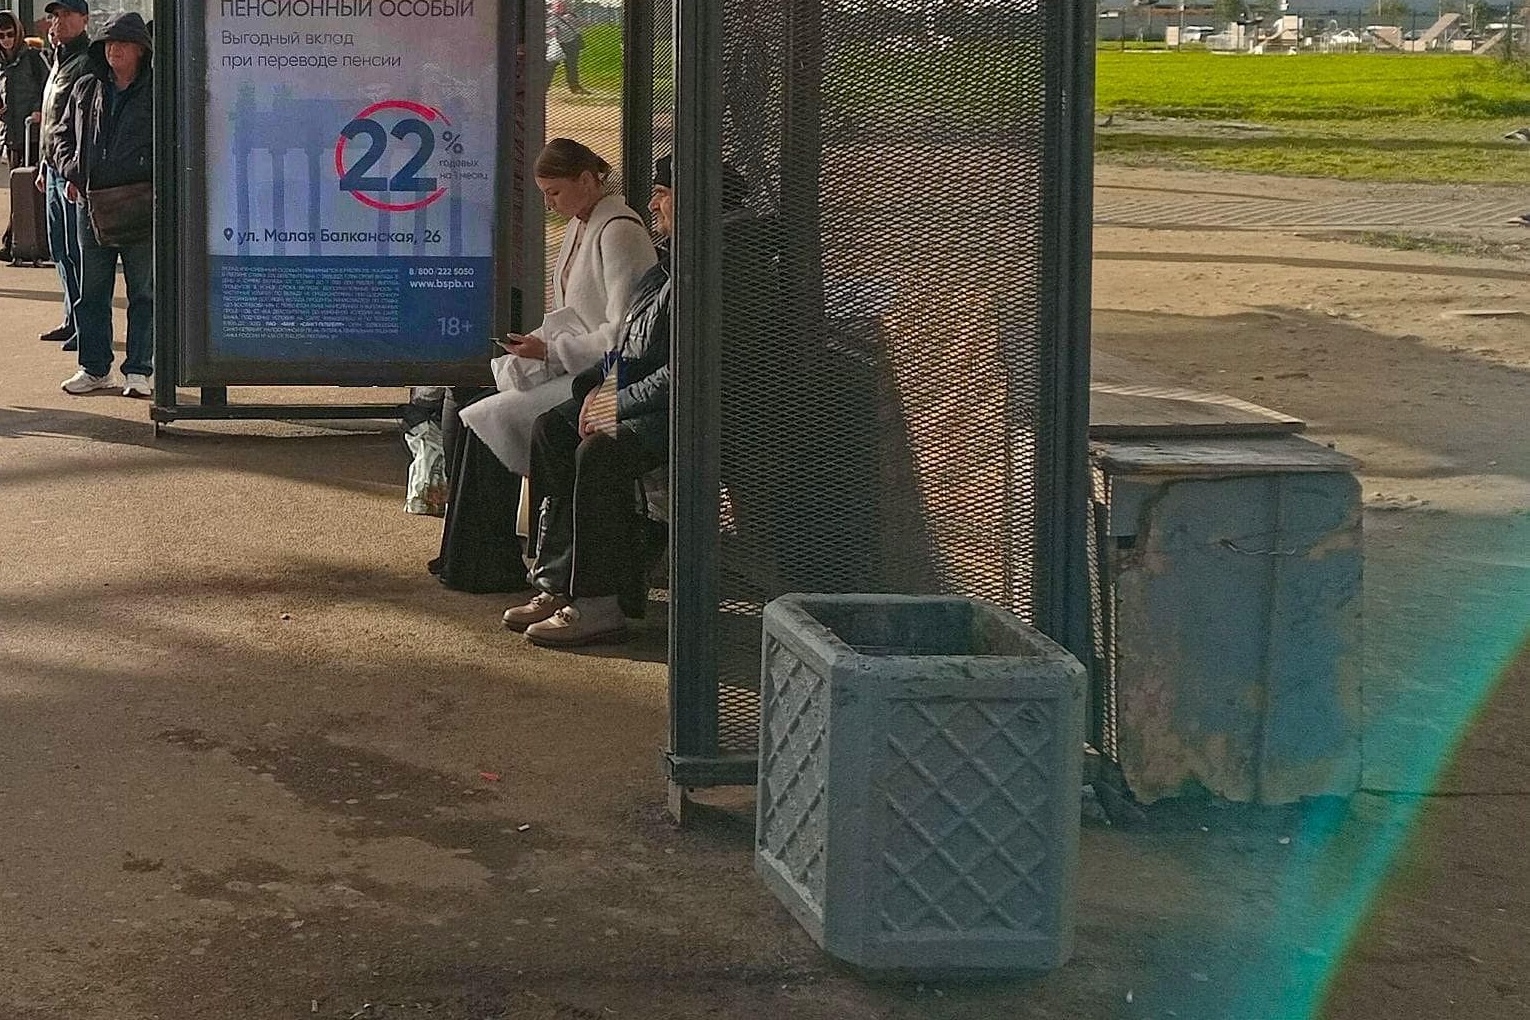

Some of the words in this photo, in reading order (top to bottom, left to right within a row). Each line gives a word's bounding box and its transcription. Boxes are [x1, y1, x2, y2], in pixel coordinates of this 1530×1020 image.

[221, 30, 301, 46] Выгодный
[305, 33, 355, 46] вклад
[221, 55, 253, 70] при
[257, 54, 338, 69] переводе
[342, 54, 402, 68] пенсии
[339, 118, 438, 192] 22
[439, 159, 479, 168] годовых
[237, 231, 259, 245] ул.
[264, 230, 315, 242] Малая
[321, 229, 418, 244] Балканская,
[423, 230, 441, 243] 26
[438, 267, 452, 275] 222
[453, 267, 474, 275] 5050
[410, 279, 474, 290] www.bspb.ru
[437, 317, 473, 336] 18+
